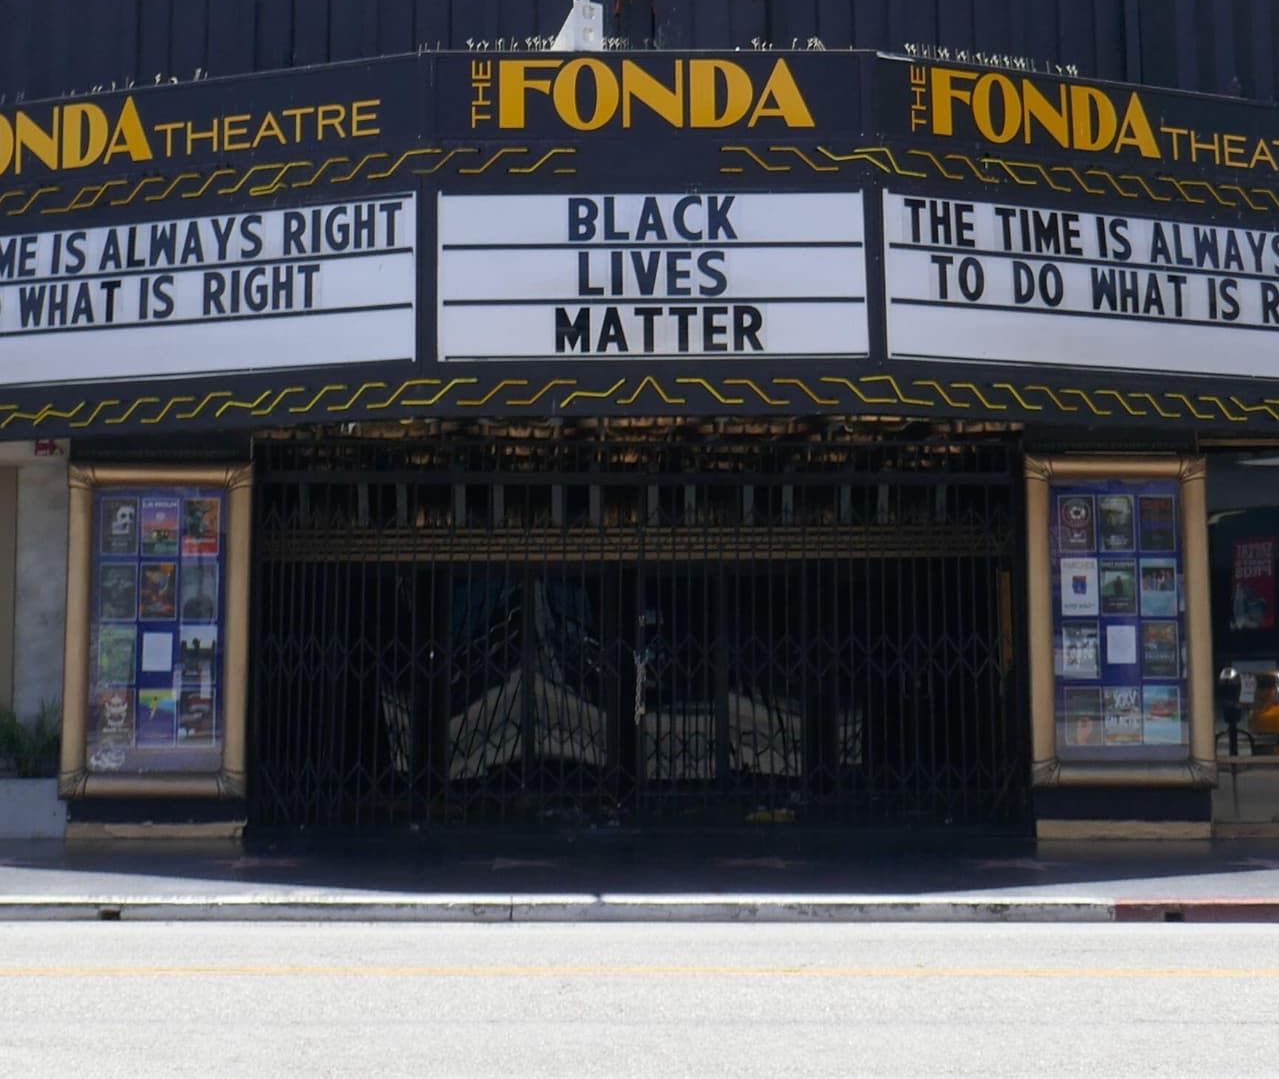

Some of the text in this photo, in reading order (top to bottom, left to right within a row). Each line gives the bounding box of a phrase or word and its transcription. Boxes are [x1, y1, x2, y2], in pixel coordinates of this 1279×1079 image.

[471, 57, 816, 131] THE FONDA
[910, 64, 927, 132] THE
[931, 66, 1162, 160] FONDA
[154, 99, 381, 158] THEATRE
[51, 231, 87, 276] IS
[99, 215, 263, 270] ALWAYS
[283, 202, 403, 256] RIGHT
[568, 195, 738, 242] BLACK
[904, 198, 975, 248] THE
[995, 207, 1083, 257] TIME
[1098, 218, 1132, 262] IS
[20, 280, 121, 328] WHAT
[139, 275, 174, 320] IS
[203, 264, 321, 316] RIGHT
[578, 250, 727, 297] LIVES
[931, 255, 984, 302] TO
[1013, 260, 1063, 308] DO
[1091, 267, 1187, 318] WHAT
[1209, 278, 1240, 321] IS
[555, 305, 764, 353] MATTER
